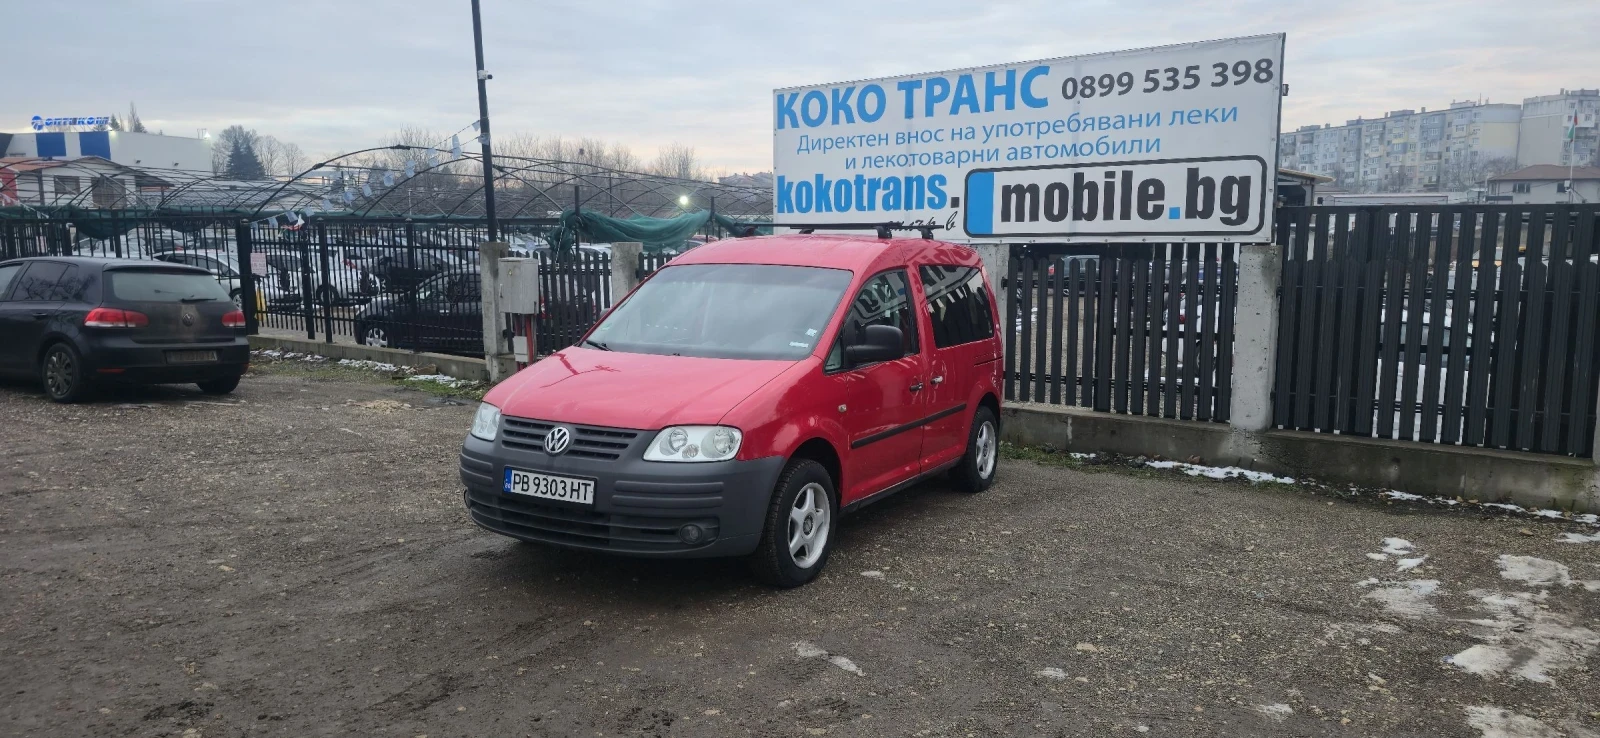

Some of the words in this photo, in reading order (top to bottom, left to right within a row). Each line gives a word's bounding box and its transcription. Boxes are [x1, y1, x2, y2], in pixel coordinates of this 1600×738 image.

[776, 83, 887, 130] КОКО
[897, 65, 1051, 119] ТРАНС
[1061, 71, 1134, 100] 0899
[1142, 64, 1201, 93] 535
[1210, 58, 1274, 87] 398
[796, 132, 889, 155] Директен
[895, 127, 944, 145] внос
[950, 123, 976, 141] на
[982, 112, 1161, 145] употребявани
[1168, 106, 1238, 126] леки
[845, 155, 857, 170] и
[861, 146, 1000, 169] лекотоварни
[1006, 135, 1161, 161] автомобили
[1001, 167, 1252, 226] mobile.bg
[512, 473, 530, 492] PB
[532, 476, 567, 498] 9303
[569, 481, 592, 501] HT
